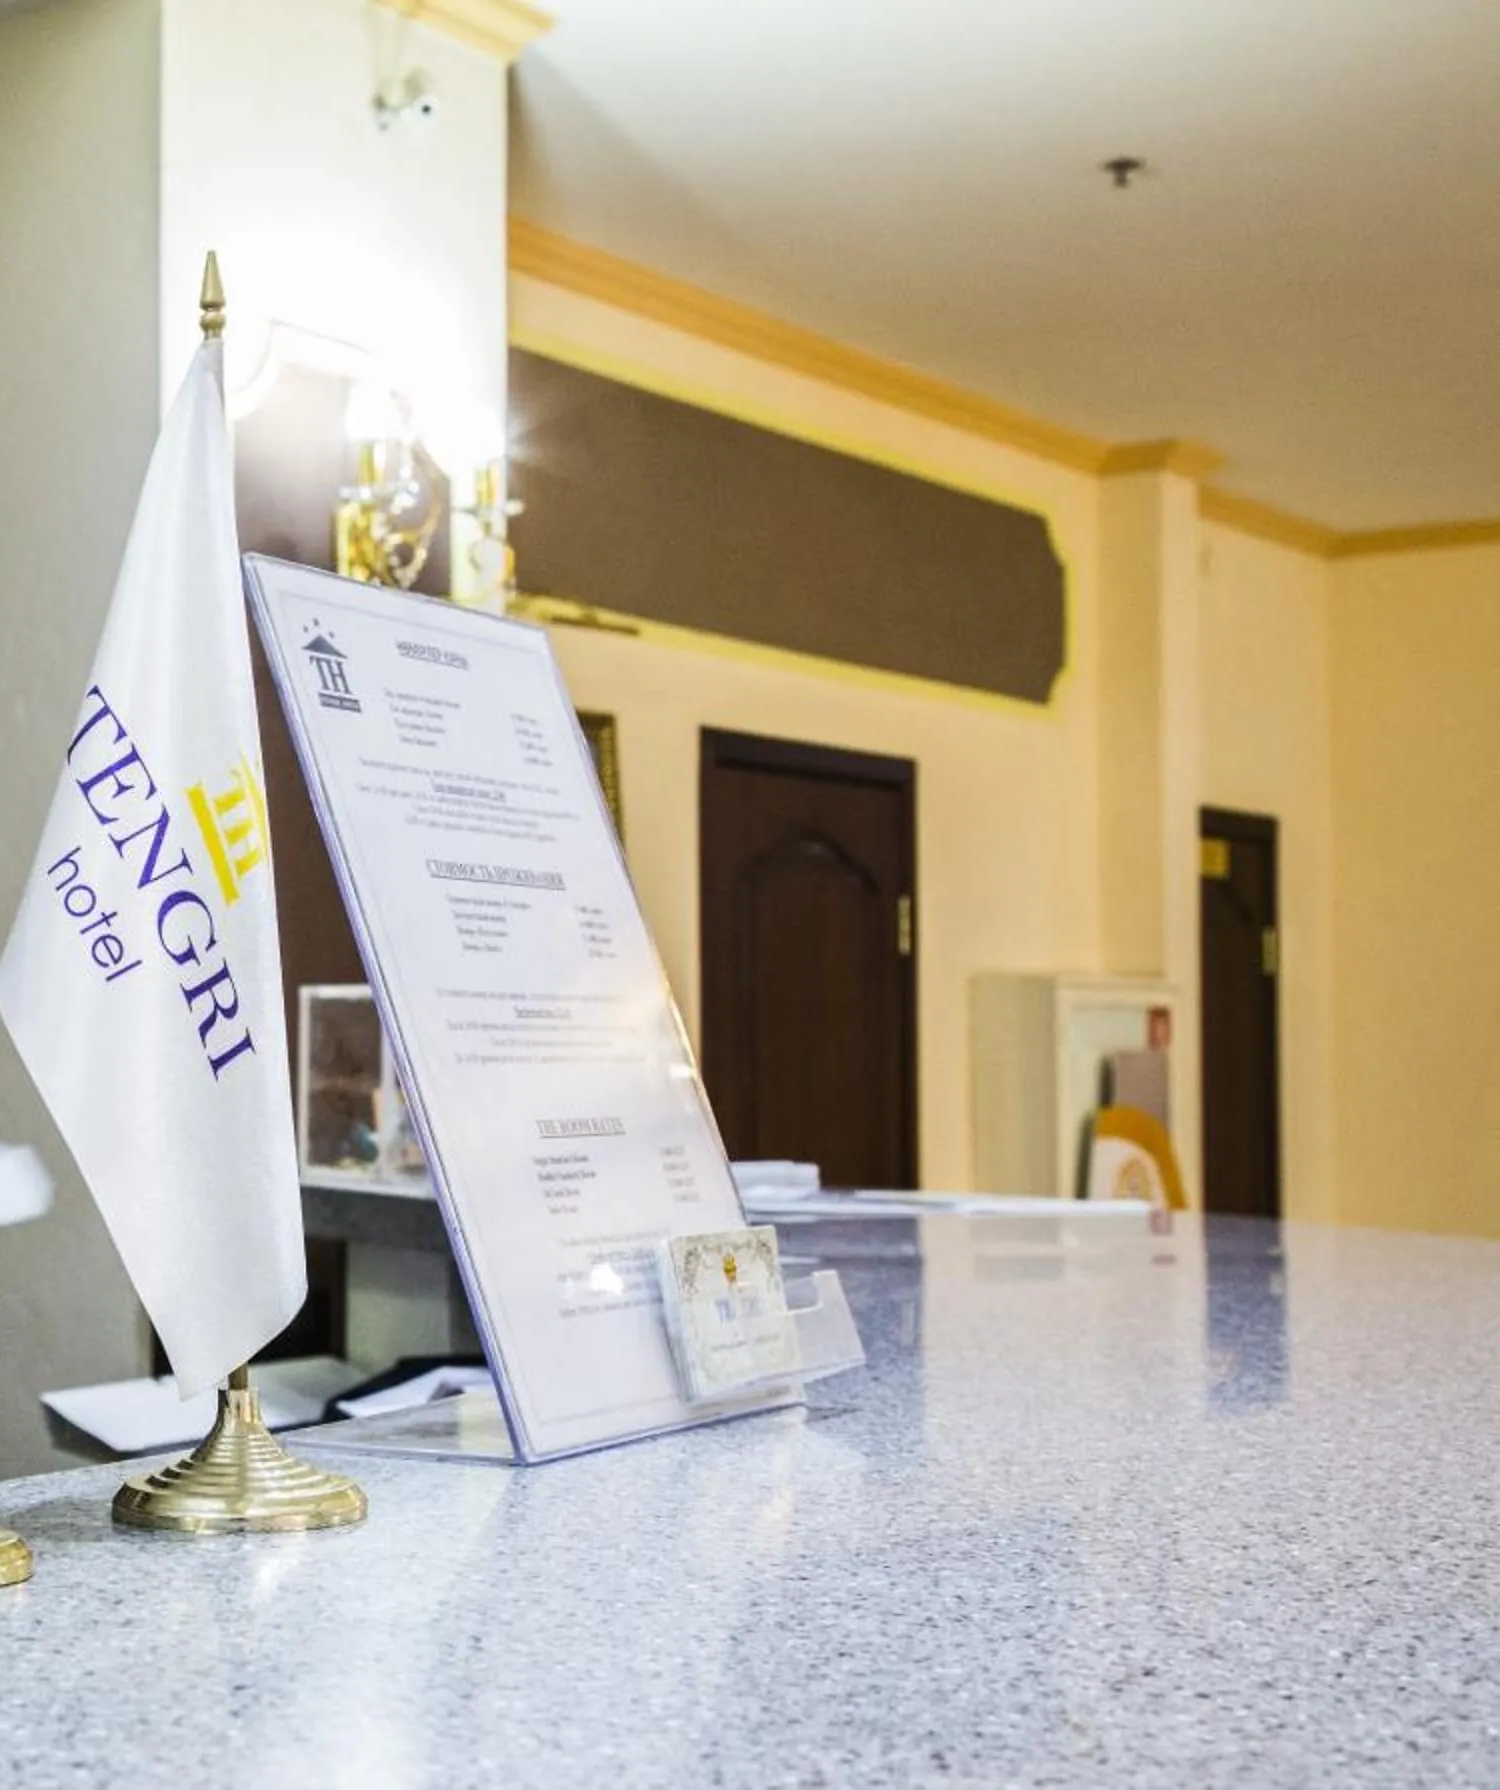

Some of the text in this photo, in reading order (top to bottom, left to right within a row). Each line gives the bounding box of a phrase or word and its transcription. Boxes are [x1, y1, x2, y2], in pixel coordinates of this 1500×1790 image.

[309, 655, 353, 694] TH
[46, 845, 143, 983] hotel
[67, 684, 257, 1082] TENGRI
